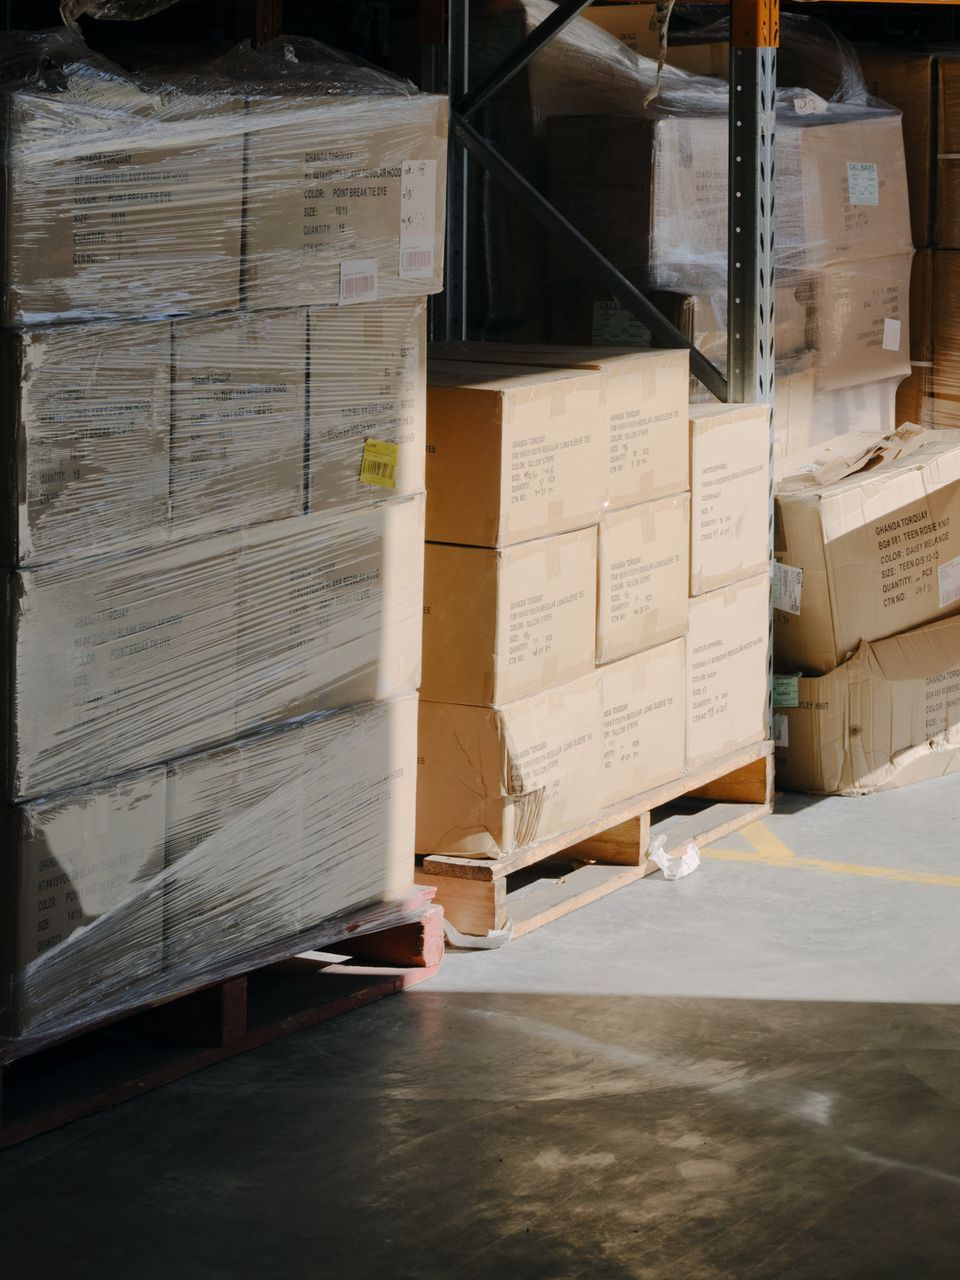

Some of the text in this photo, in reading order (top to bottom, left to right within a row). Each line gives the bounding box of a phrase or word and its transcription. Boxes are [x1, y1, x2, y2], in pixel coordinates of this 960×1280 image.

[876, 511, 928, 536] GHANDA TORQUAY
[903, 528, 919, 542] TEEN
[919, 522, 938, 537] ROSIE
[938, 517, 951, 531] KNIT
[906, 542, 923, 557] DAISY
[923, 531, 949, 549] MELANGE
[881, 566, 897, 579] SIZE:
[899, 559, 915, 572] TEEN
[882, 576, 914, 593] QUANTITY:
[922, 567, 934, 579] PCS
[883, 593, 896, 608] CTN
